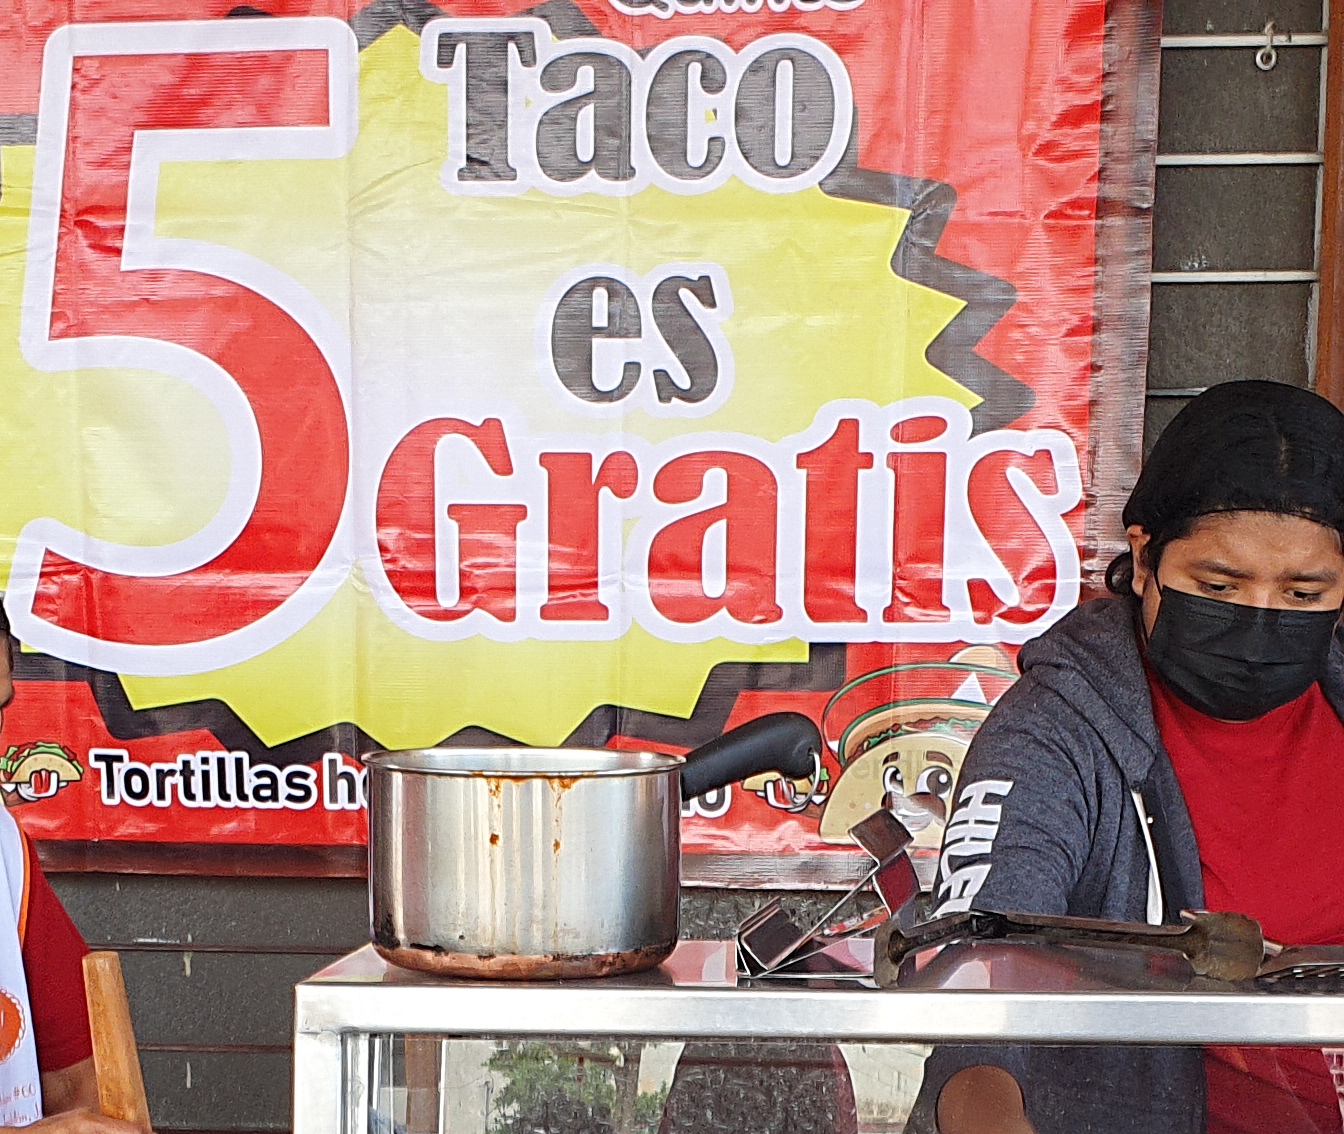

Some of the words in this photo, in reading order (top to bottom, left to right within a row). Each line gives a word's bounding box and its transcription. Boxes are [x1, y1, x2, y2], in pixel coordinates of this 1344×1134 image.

[432, 24, 836, 186] Taco
[29, 40, 356, 648] 5
[548, 268, 722, 406] es
[373, 411, 1060, 628] Gratis
[93, 752, 313, 805] Tortillas
